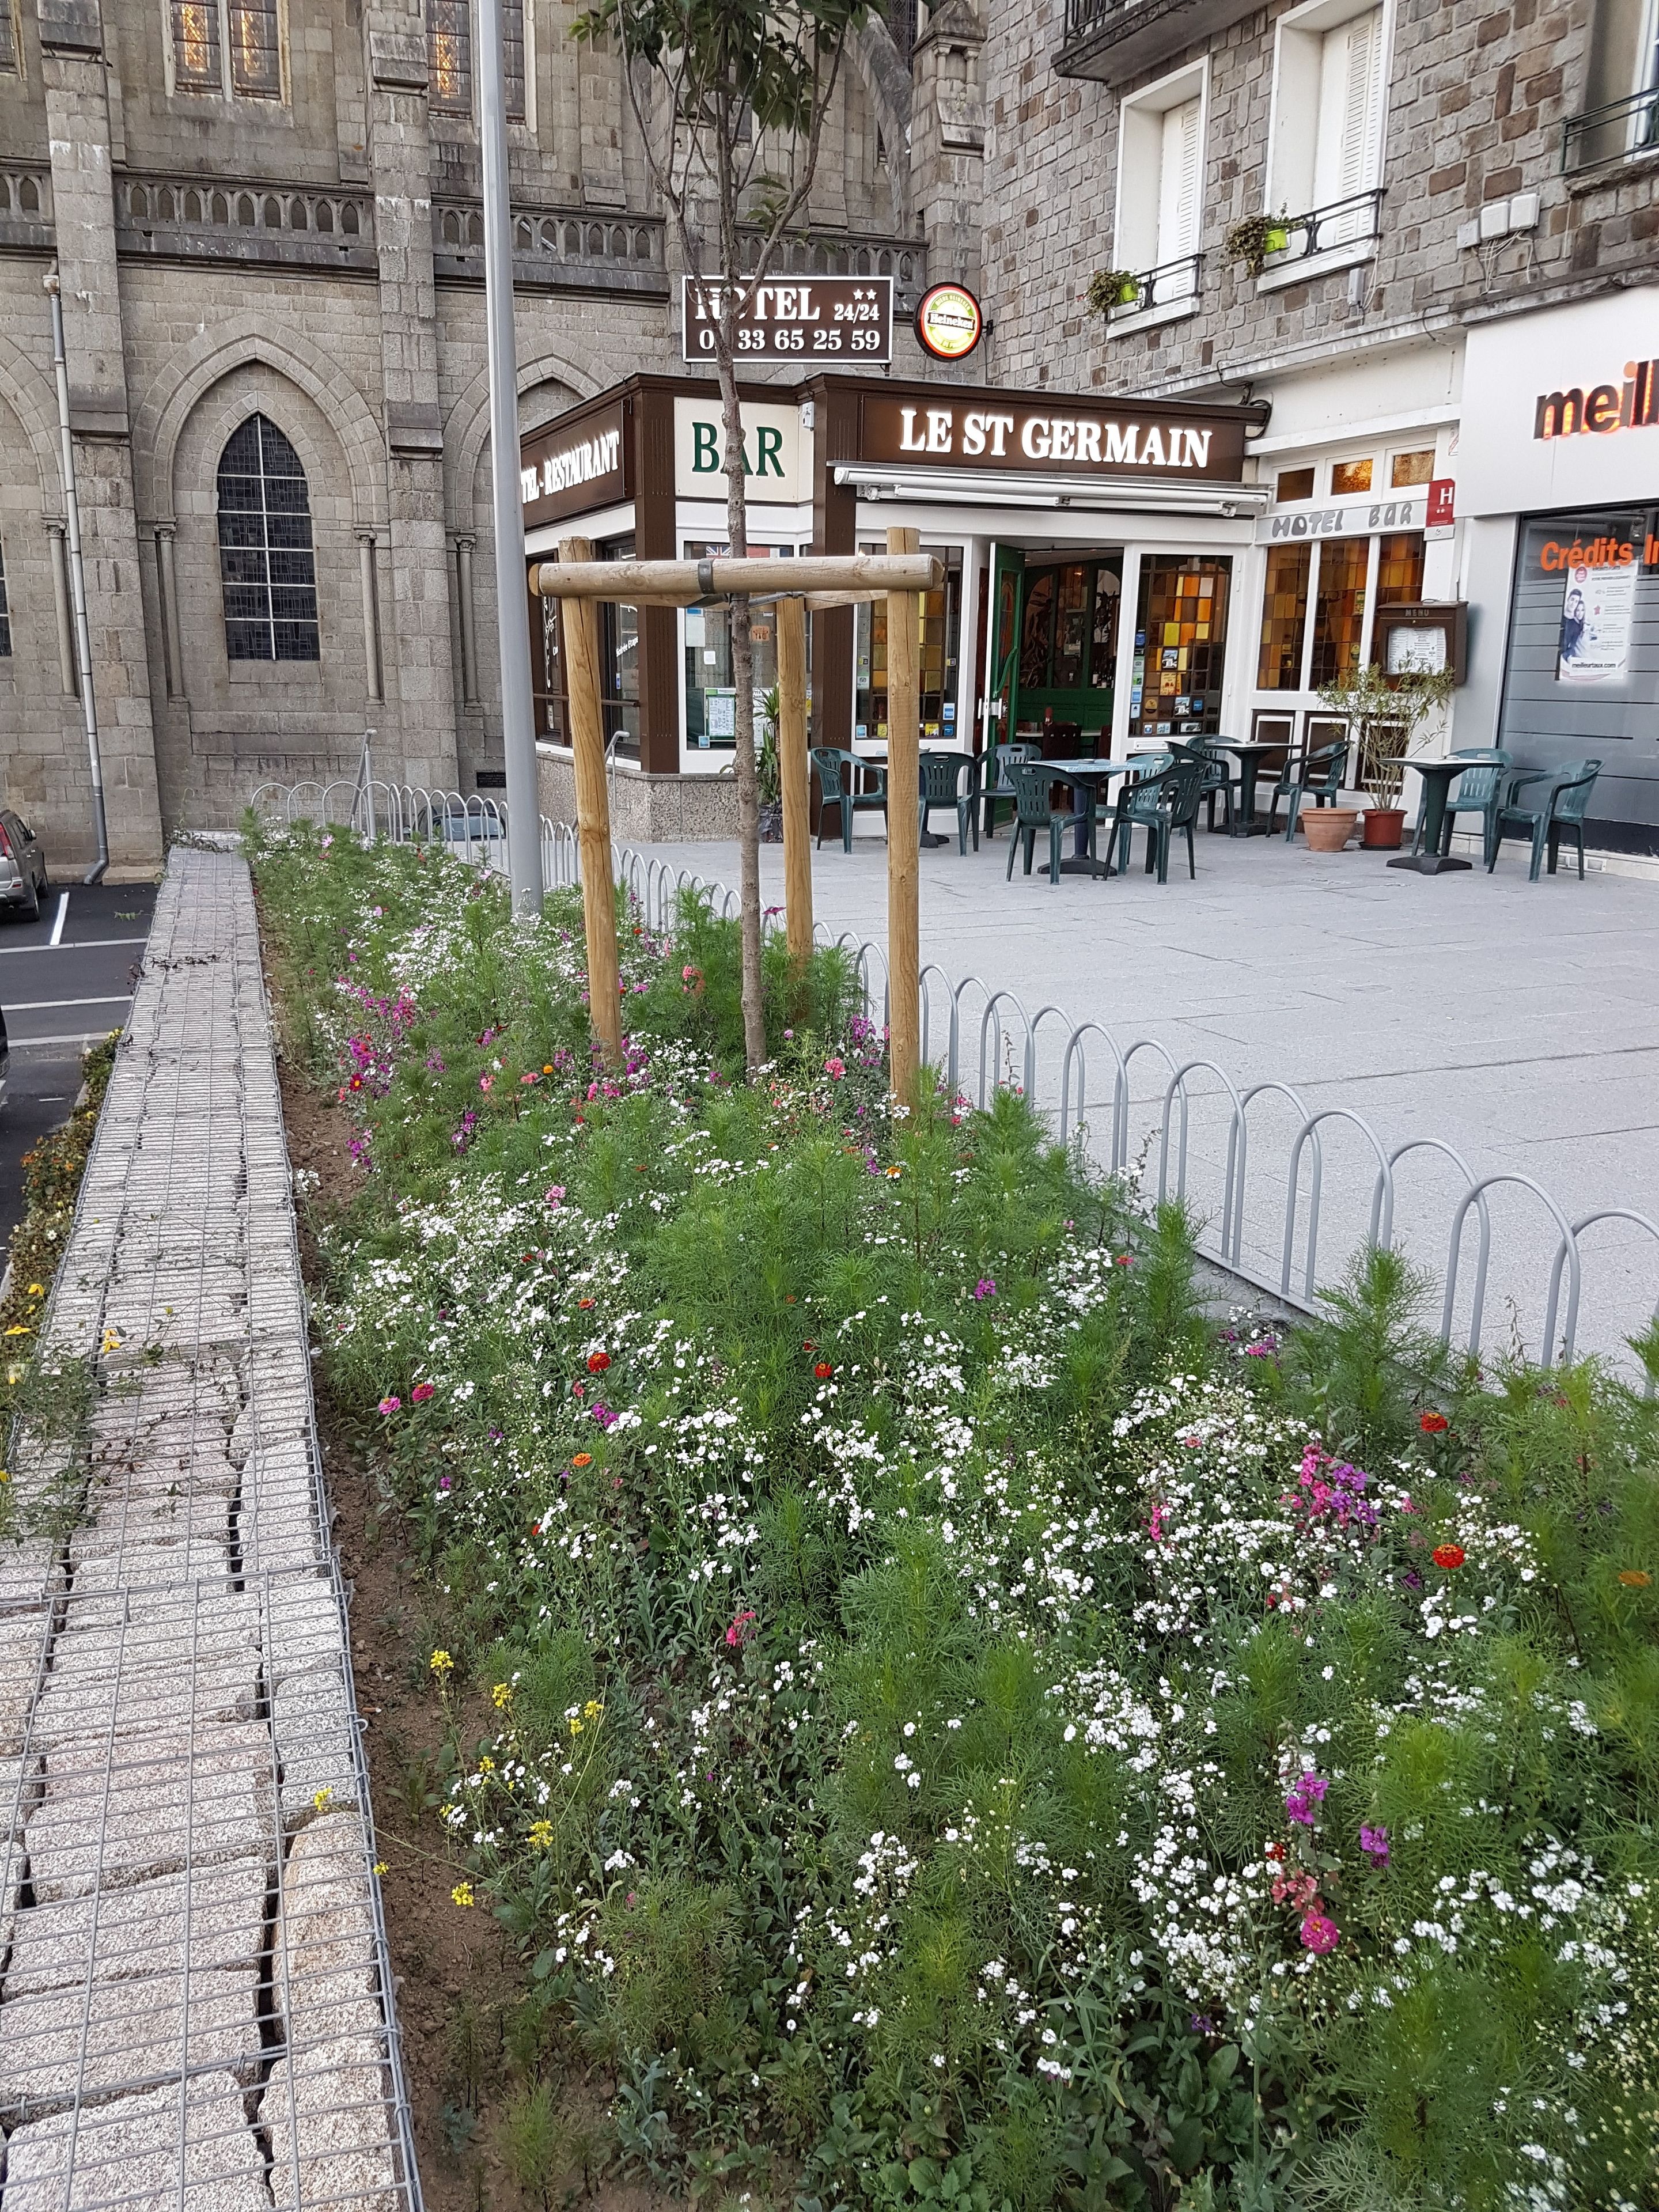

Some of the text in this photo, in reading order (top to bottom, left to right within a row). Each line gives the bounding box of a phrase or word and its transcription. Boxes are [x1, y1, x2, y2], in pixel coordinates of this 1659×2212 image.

[834, 304, 880, 324] 24/24
[930, 313, 974, 329] Heineken
[738, 329, 766, 350] 33
[774, 329, 805, 350] 65
[813, 329, 842, 350] 25
[851, 329, 880, 350] 59
[899, 408, 1213, 468] LE ST GERMAIN
[520, 430, 620, 504] TEL RESTAURANT
[1440, 486, 1454, 505] H
[1272, 502, 1412, 538] HOTEL BAR
[1540, 537, 1634, 571] Crédits
[1406, 608, 1430, 617] MENU
